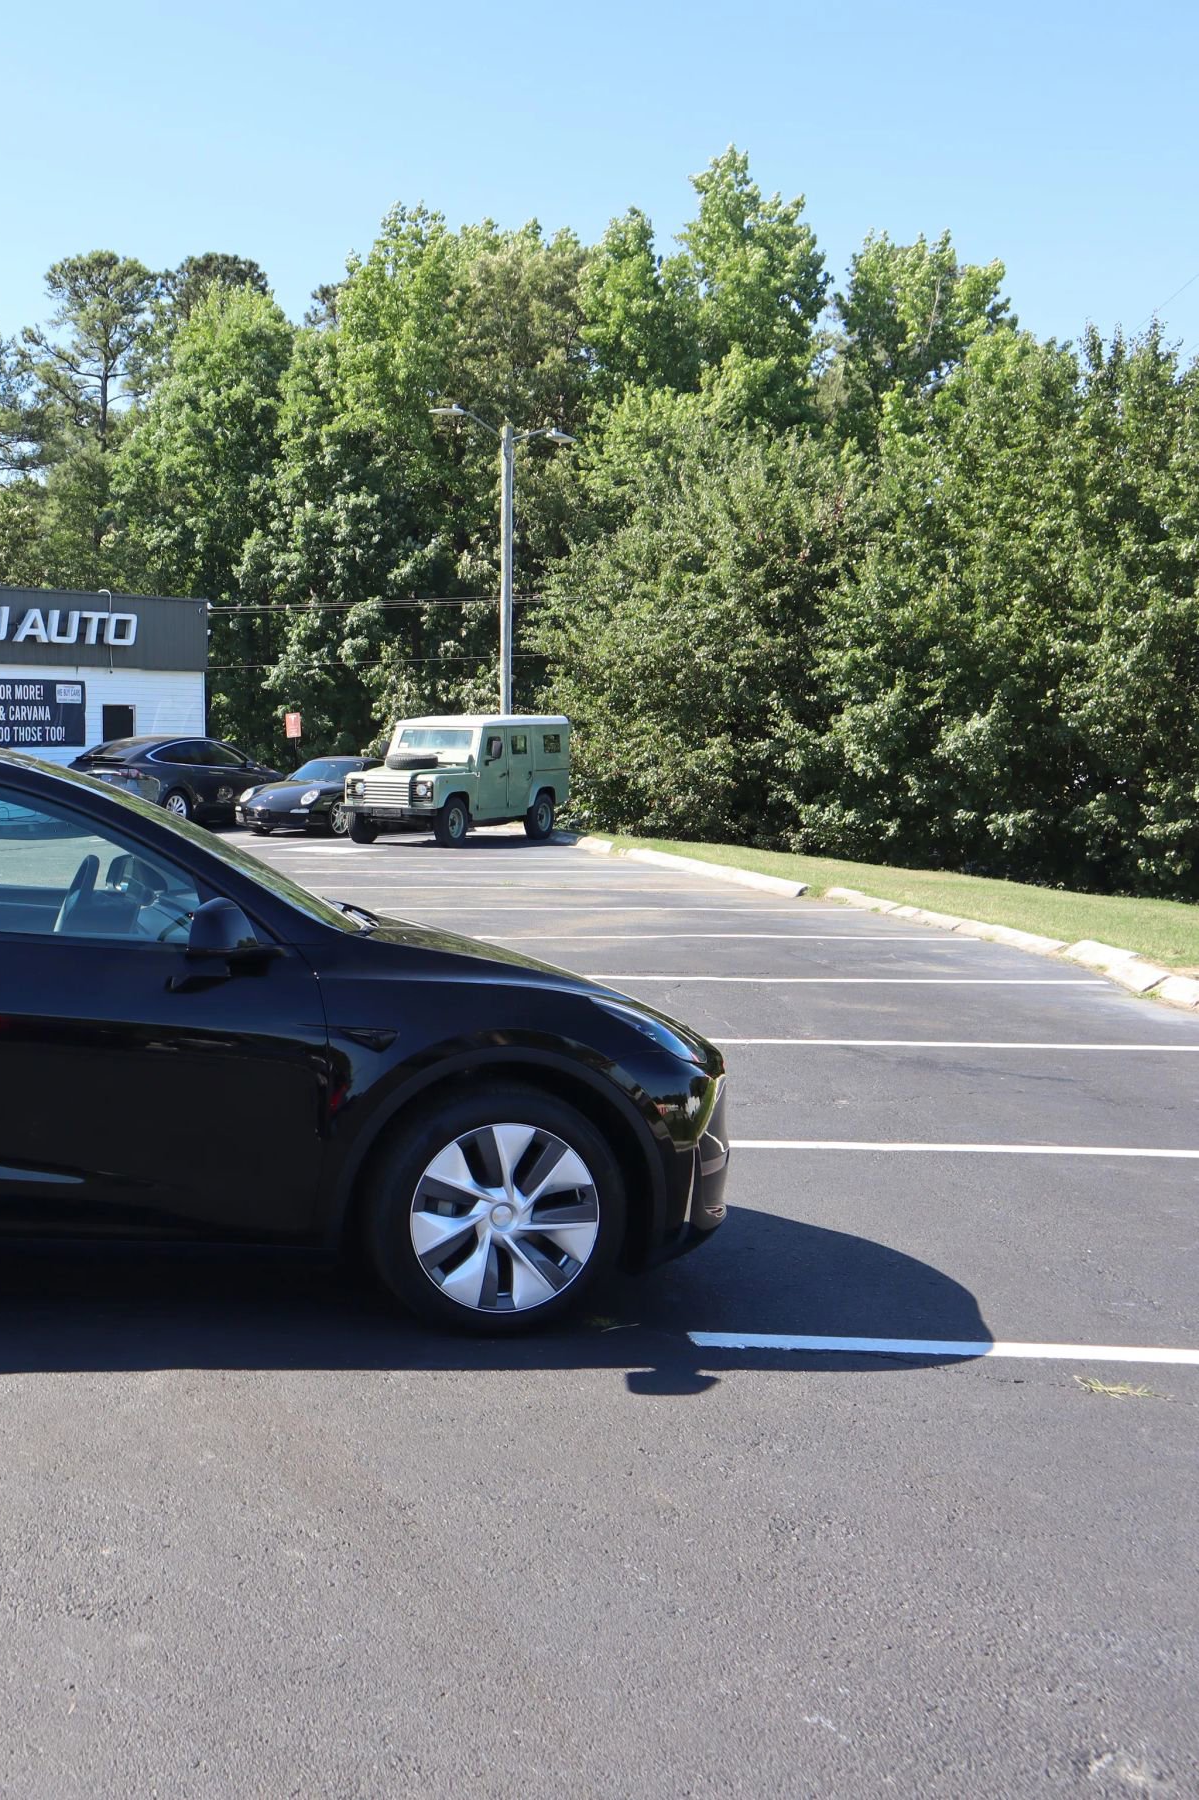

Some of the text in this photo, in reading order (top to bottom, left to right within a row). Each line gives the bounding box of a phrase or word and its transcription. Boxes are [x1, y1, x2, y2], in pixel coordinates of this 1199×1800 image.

[12, 608, 137, 646] AUTO
[15, 684, 44, 701] MORE!
[8, 706, 51, 722] CARVANA
[13, 727, 42, 742] THOSE
[45, 727, 65, 742] TOO!
